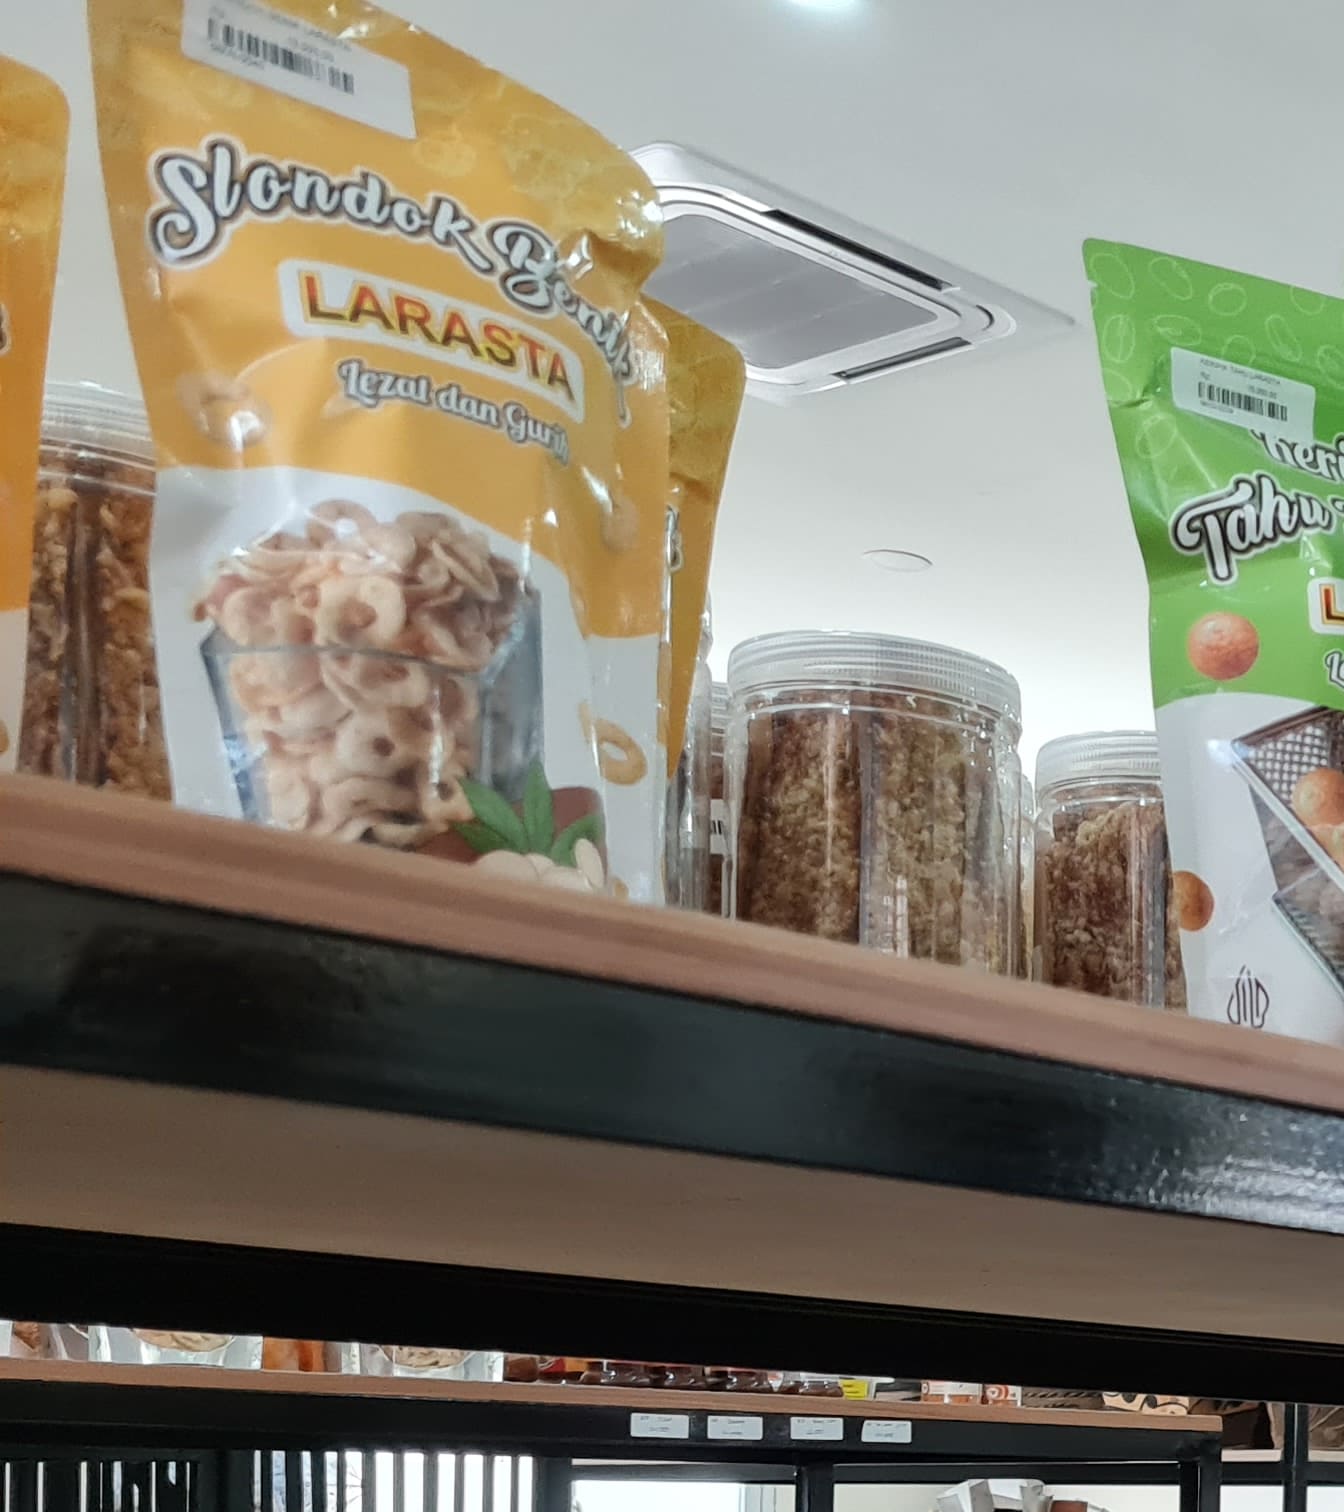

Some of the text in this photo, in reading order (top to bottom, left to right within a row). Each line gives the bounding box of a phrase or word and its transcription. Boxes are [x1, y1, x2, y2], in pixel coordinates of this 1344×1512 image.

[153, 138, 495, 273] Slondok
[299, 269, 577, 403] LARASTA
[435, 383, 500, 429] dan
[1172, 473, 1332, 581] Tahu
